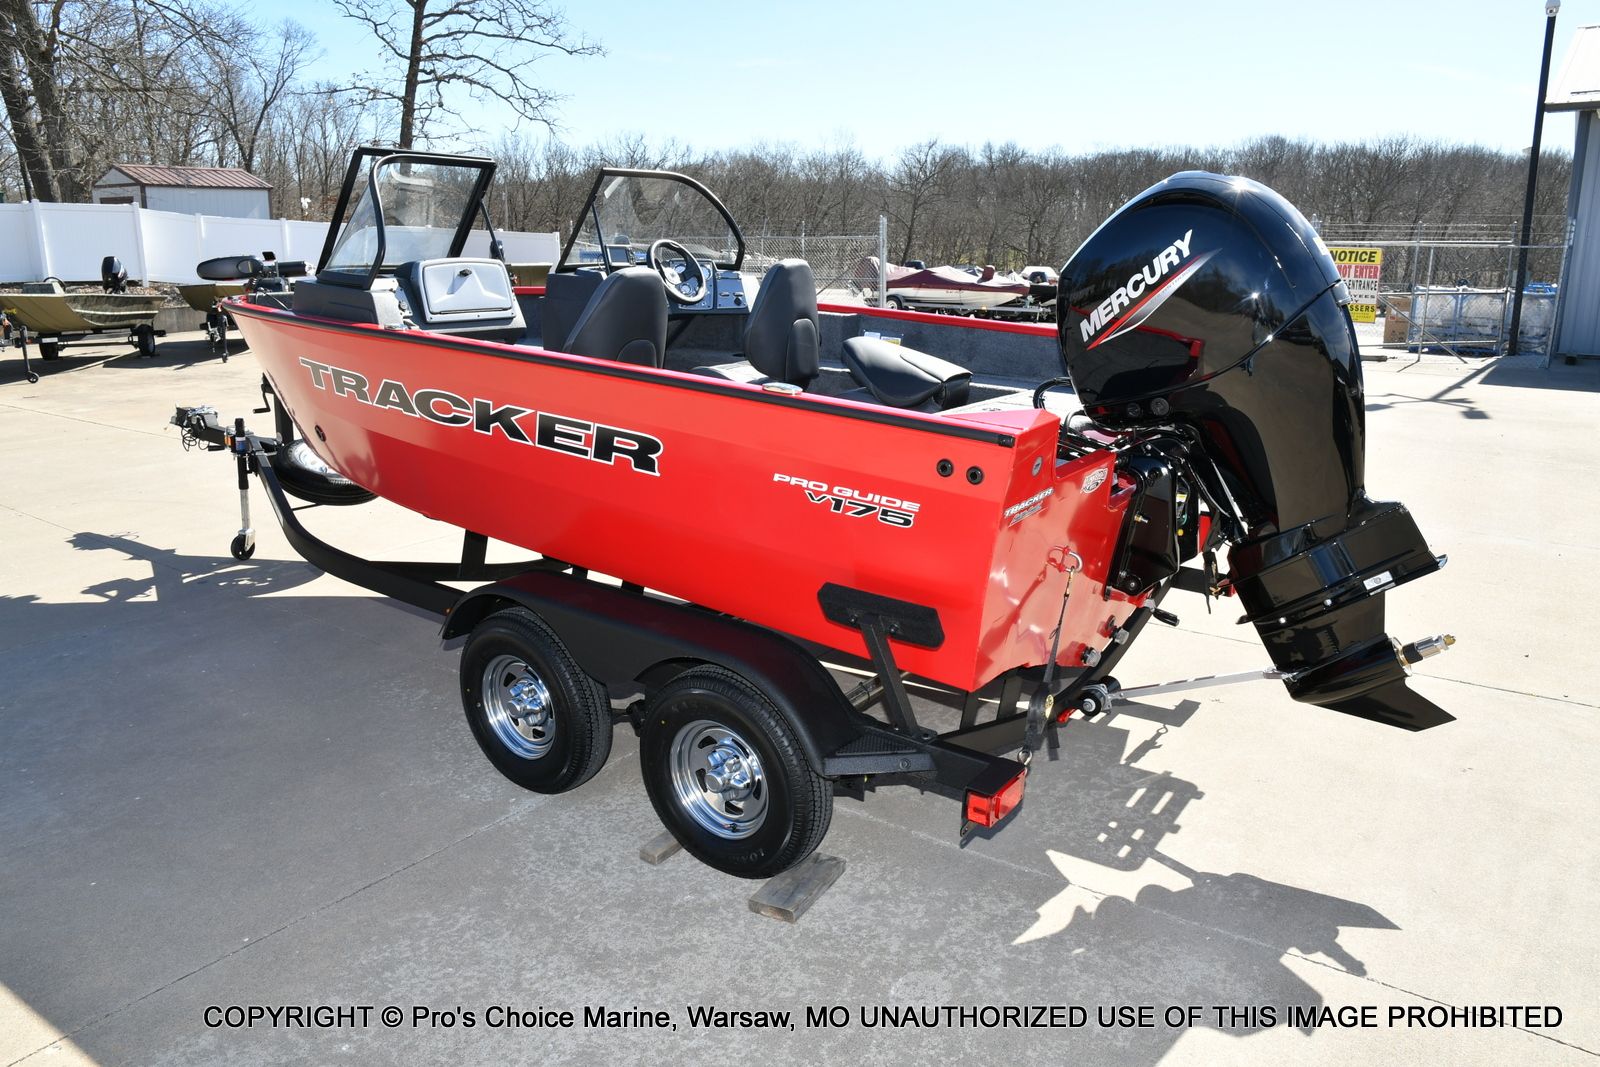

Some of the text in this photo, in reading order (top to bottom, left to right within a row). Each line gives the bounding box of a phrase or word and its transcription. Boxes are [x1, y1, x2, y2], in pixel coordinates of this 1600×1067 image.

[1330, 250, 1377, 262] NOTICE
[1354, 265, 1378, 278] ENTER
[1079, 228, 1193, 343] MERCURY
[298, 356, 665, 477] TRACKER
[772, 472, 921, 512] PRO GUIDE
[804, 489, 916, 528] V175
[1003, 487, 1054, 518] TRACKER
